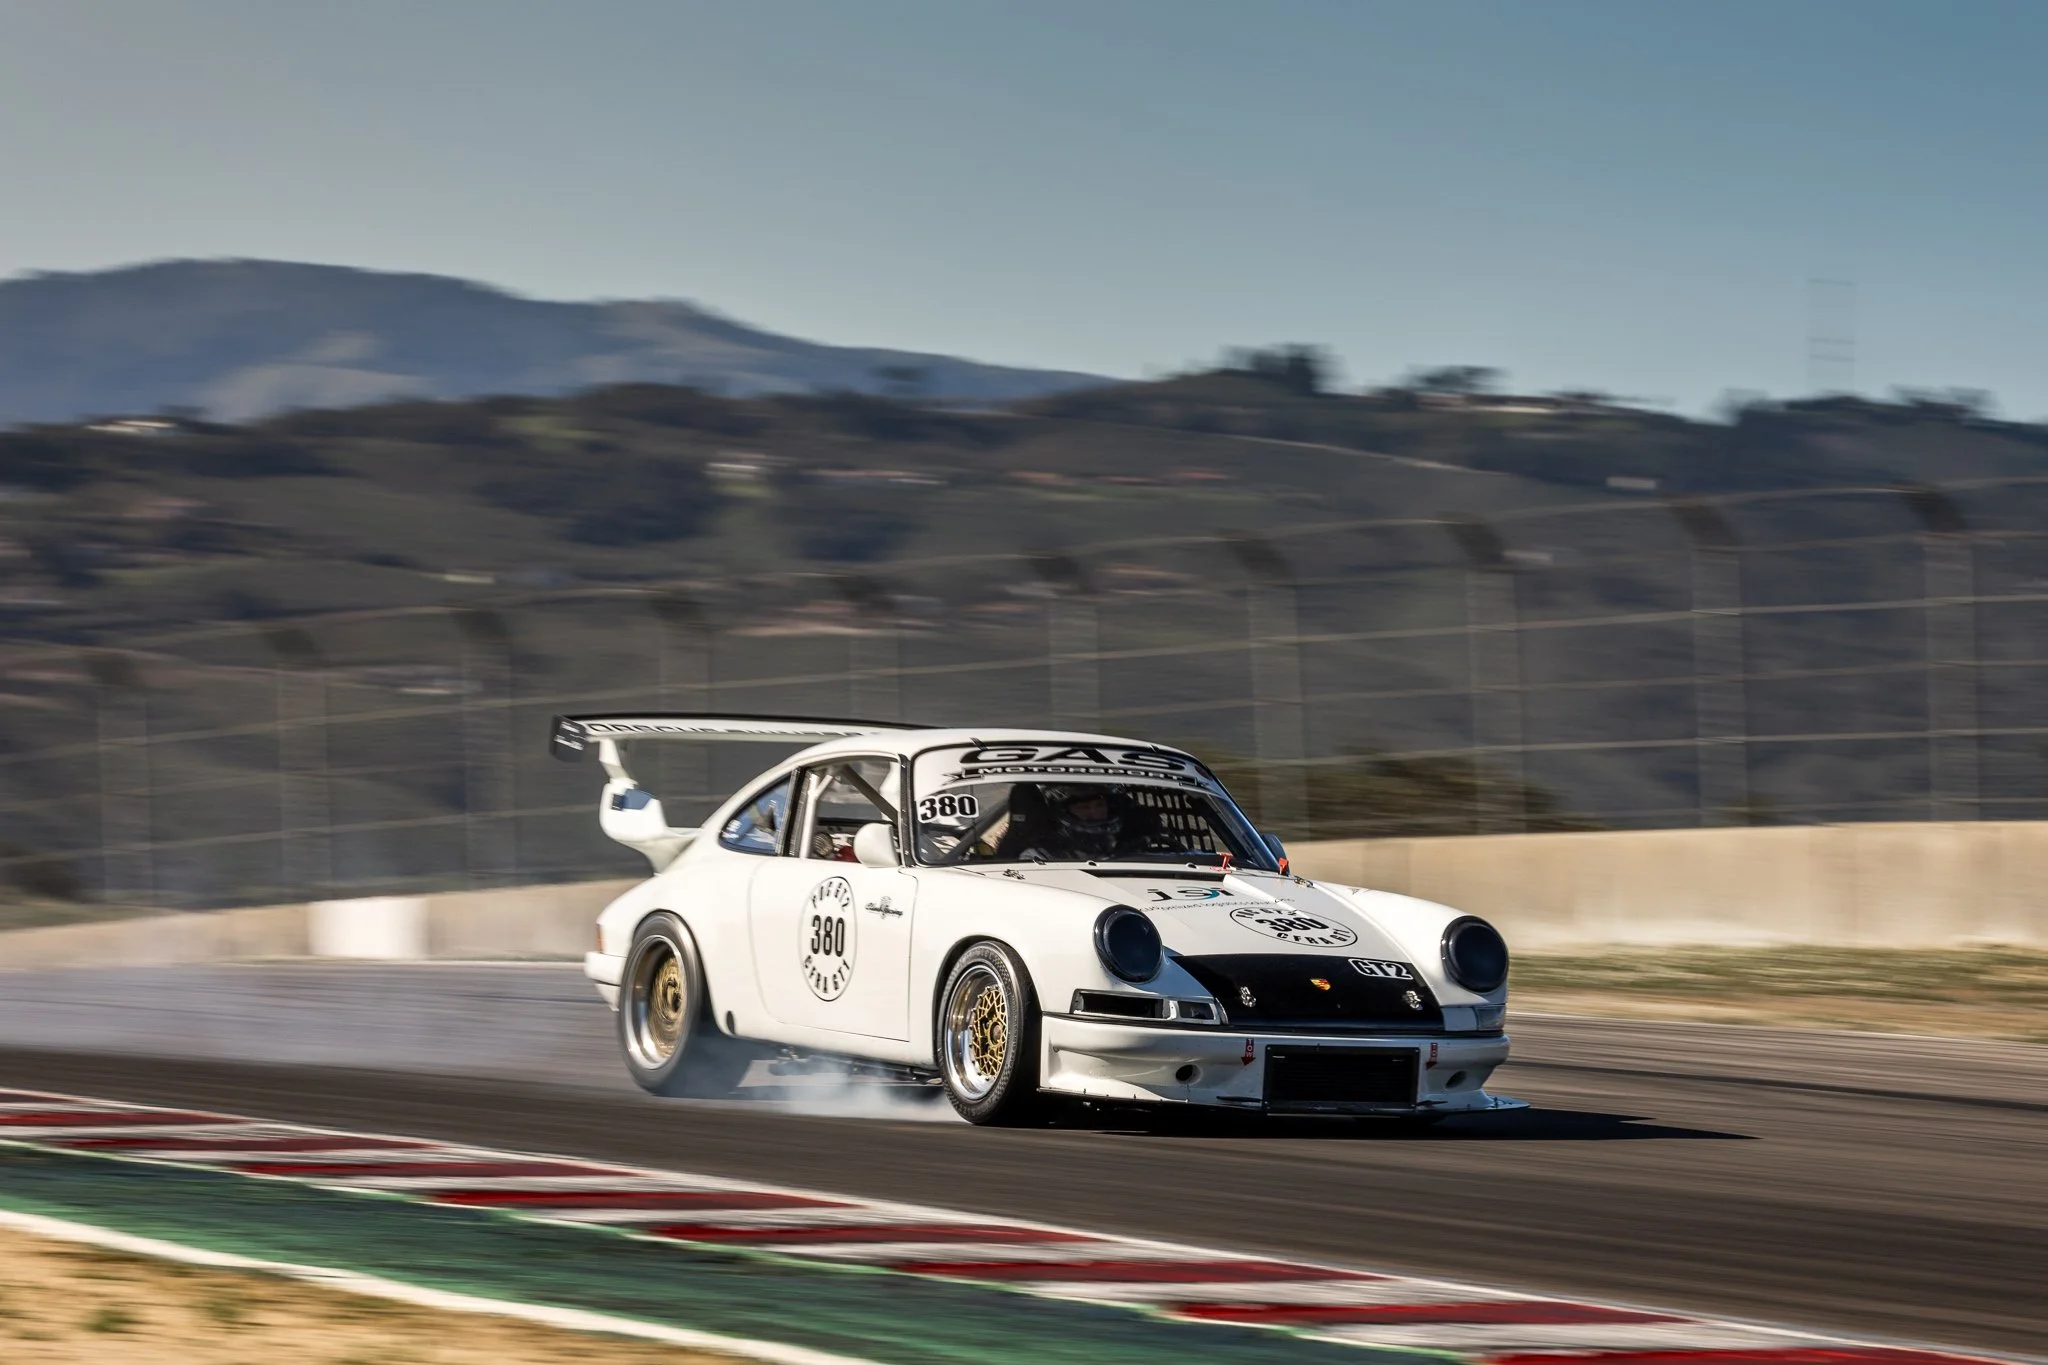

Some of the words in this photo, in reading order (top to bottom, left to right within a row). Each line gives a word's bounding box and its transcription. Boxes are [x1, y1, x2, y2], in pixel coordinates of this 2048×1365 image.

[959, 747, 1186, 771] GAS
[978, 766, 1184, 780] MOTORSPORT
[919, 795, 977, 821] 380
[811, 914, 845, 957] 380
[1254, 917, 1330, 933] 380
[1349, 959, 1413, 979] GT2
